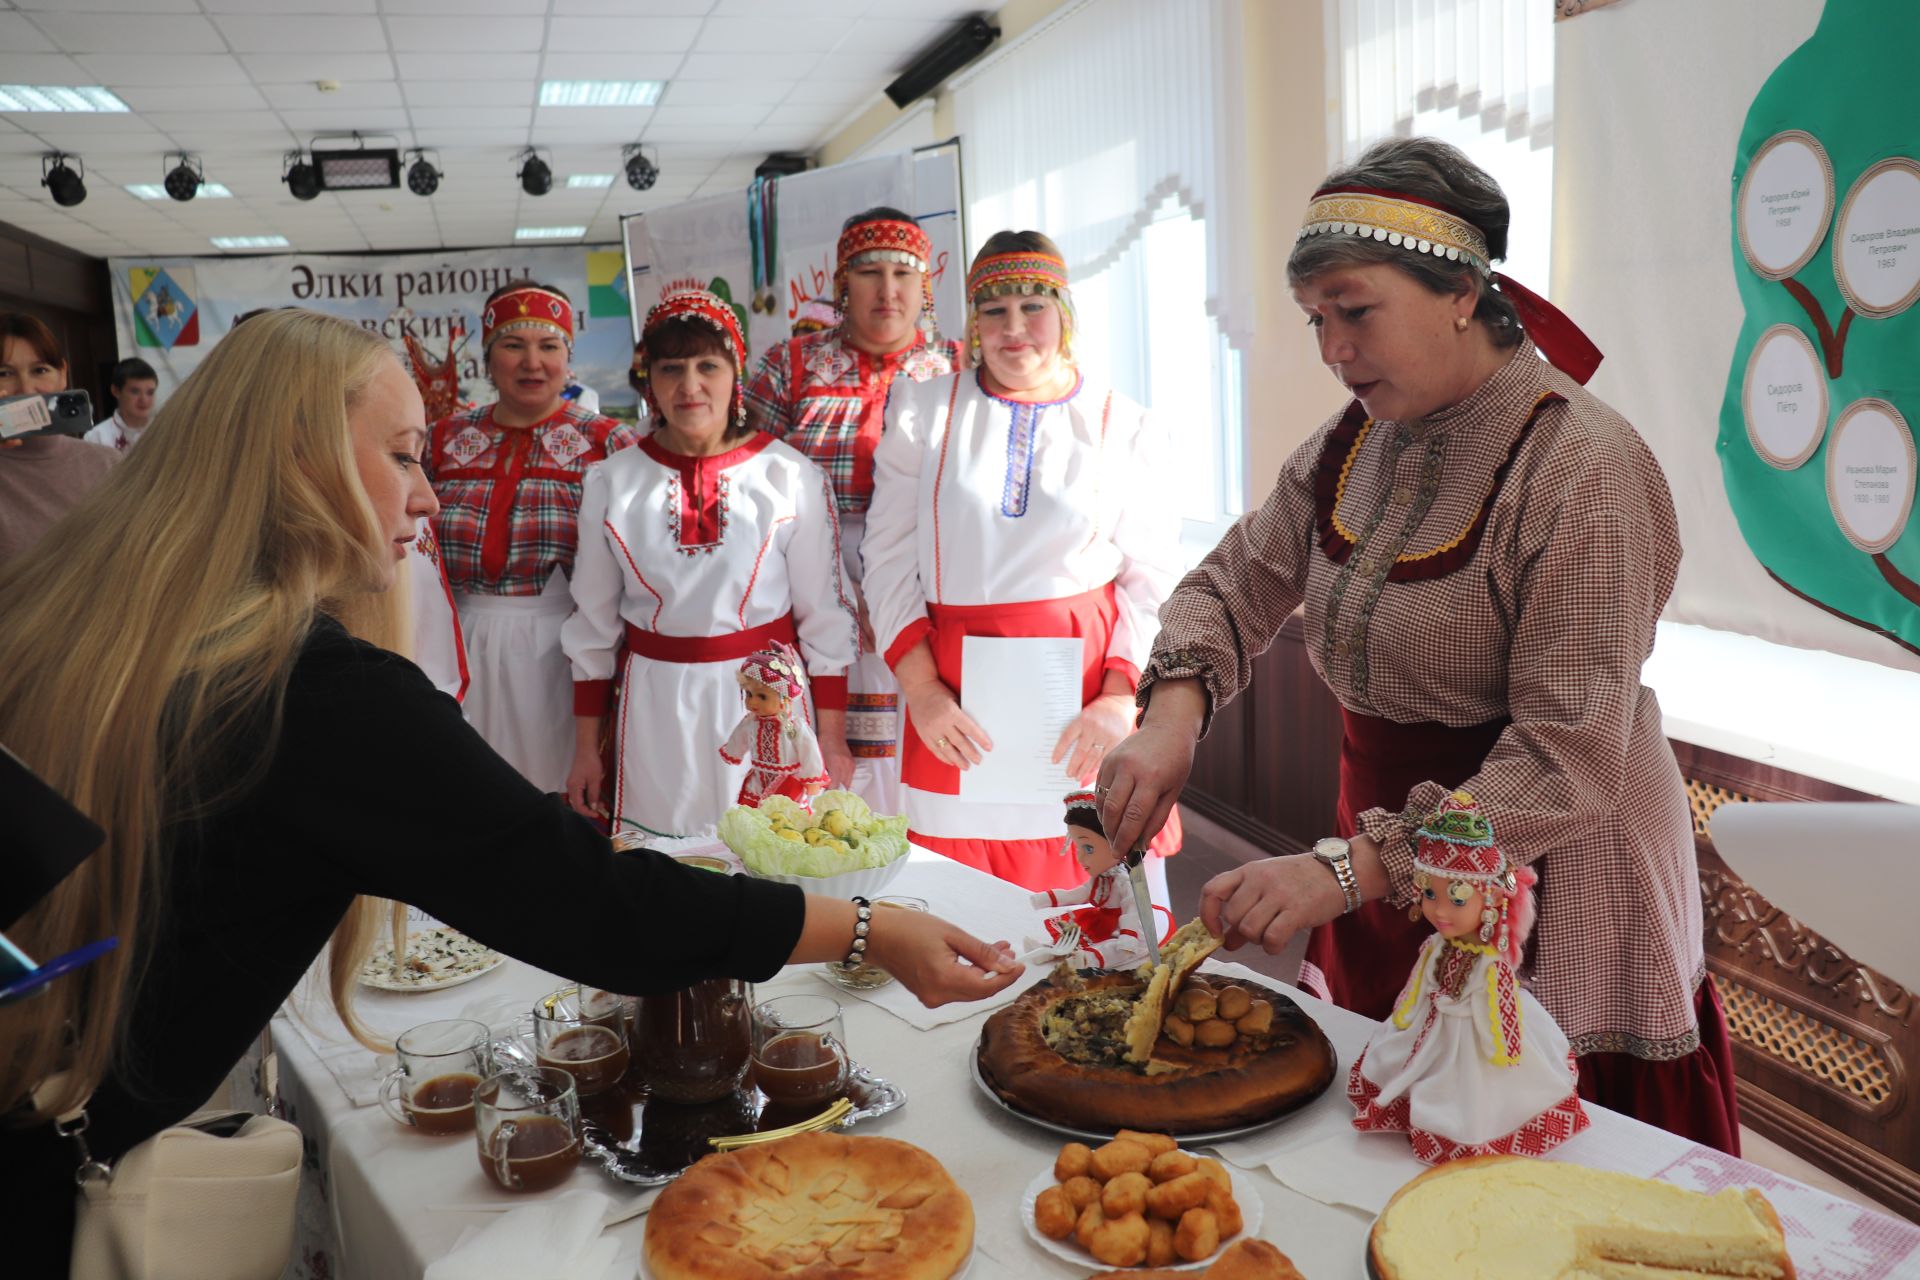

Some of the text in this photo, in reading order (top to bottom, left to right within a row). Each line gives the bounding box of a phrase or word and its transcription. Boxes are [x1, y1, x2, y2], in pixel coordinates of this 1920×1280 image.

[1850, 232, 1885, 243] Сидоров
[1869, 244, 1907, 256] Петрович
[291, 264, 384, 300] Әлки
[1767, 383, 1803, 397] Сидоров
